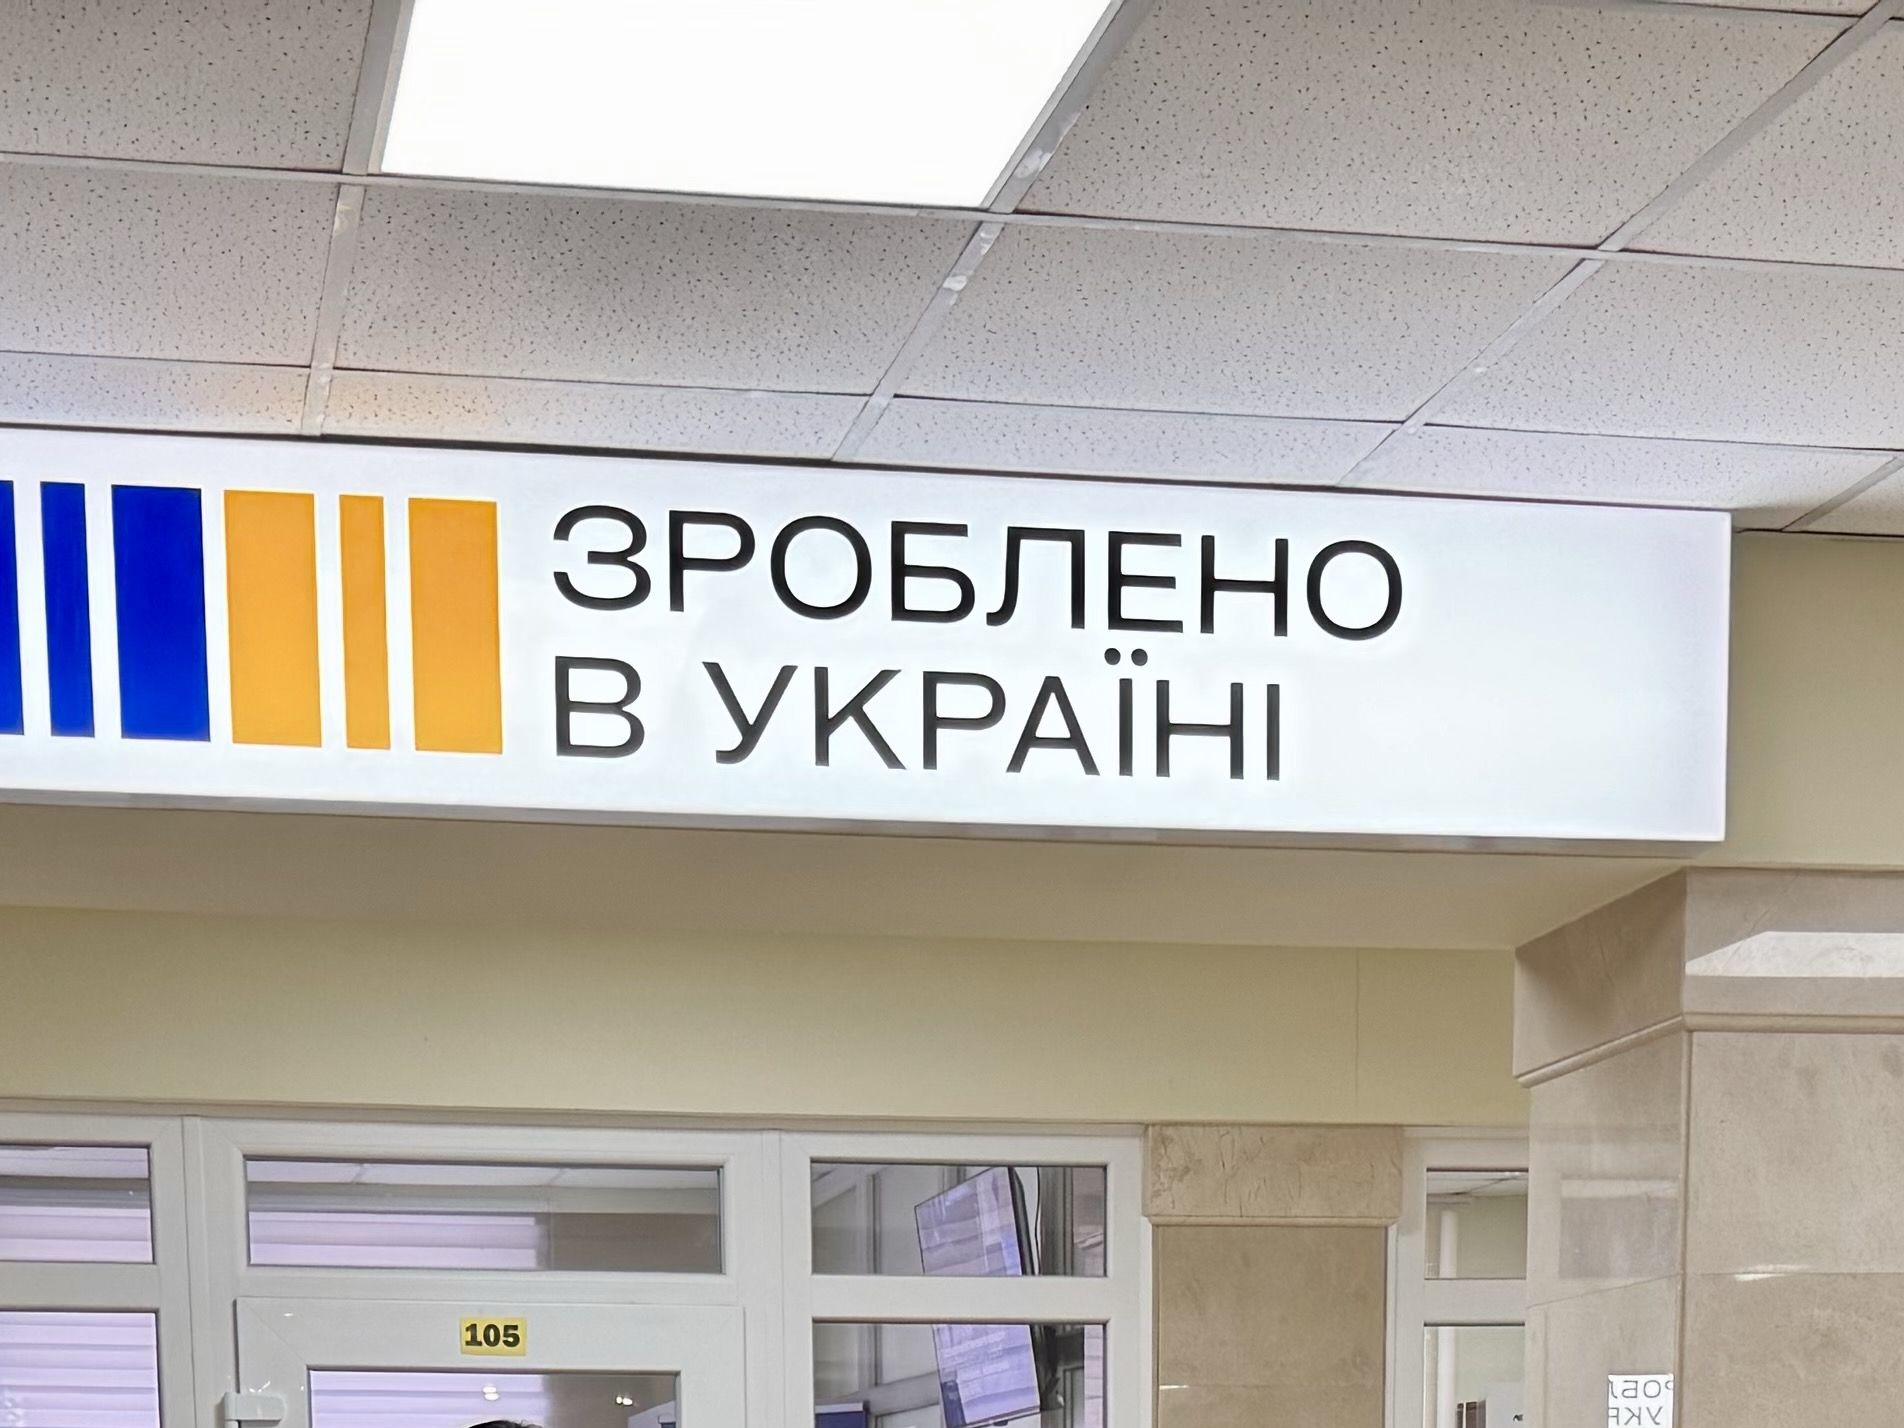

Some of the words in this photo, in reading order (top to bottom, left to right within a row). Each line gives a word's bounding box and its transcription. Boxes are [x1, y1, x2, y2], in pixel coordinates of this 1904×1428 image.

[553, 504, 1403, 641] ЗРОБЛЕНО
[555, 655, 645, 759] В
[702, 647, 1280, 781] УКРАЇНІ
[465, 1323, 521, 1348] 105
